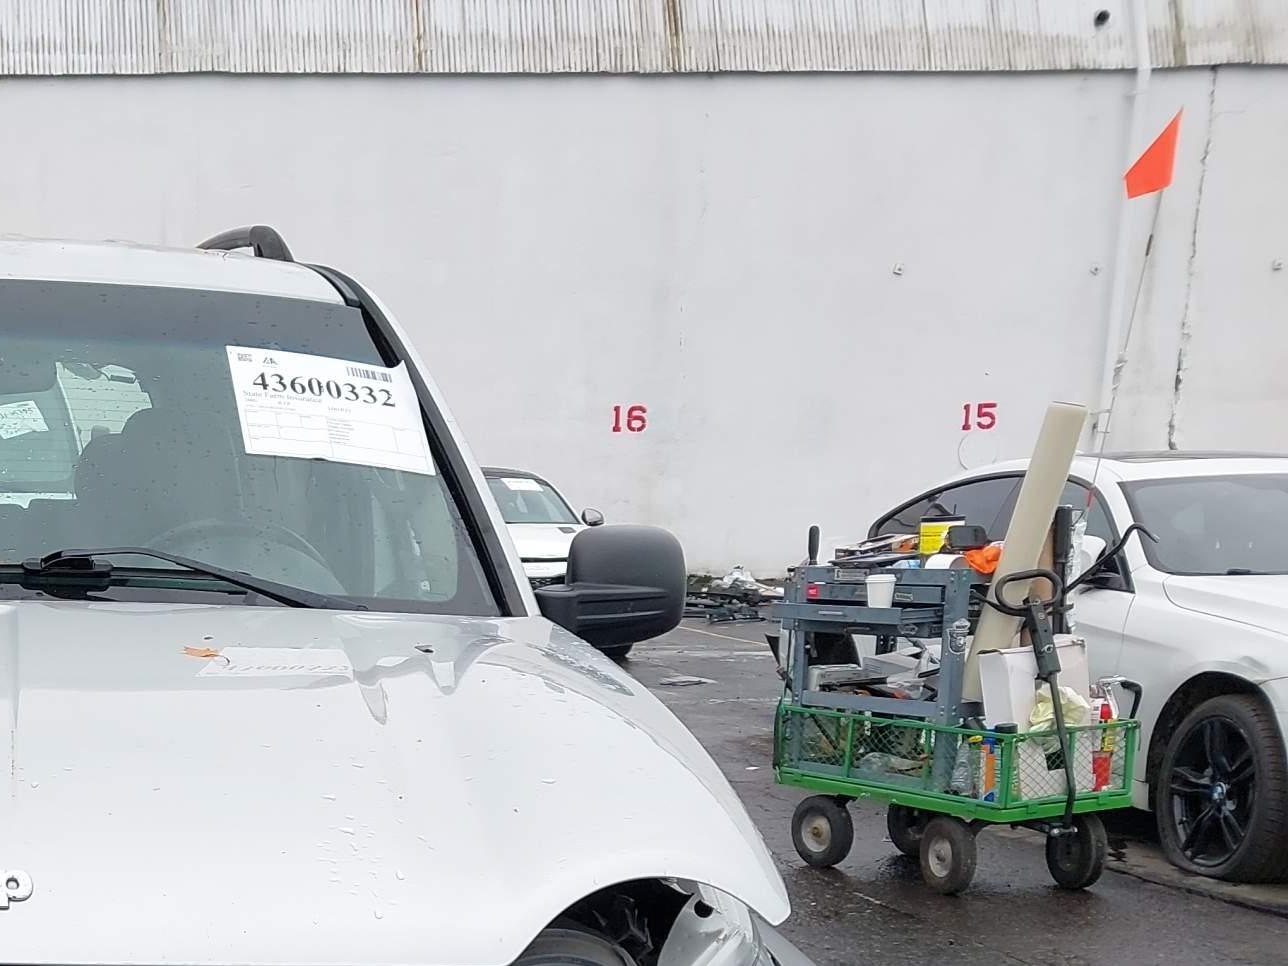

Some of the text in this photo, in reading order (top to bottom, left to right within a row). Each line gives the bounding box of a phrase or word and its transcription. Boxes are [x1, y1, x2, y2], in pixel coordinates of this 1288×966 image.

[252, 371, 396, 408] 43600332
[612, 405, 647, 433] 16
[961, 402, 998, 431] 15
